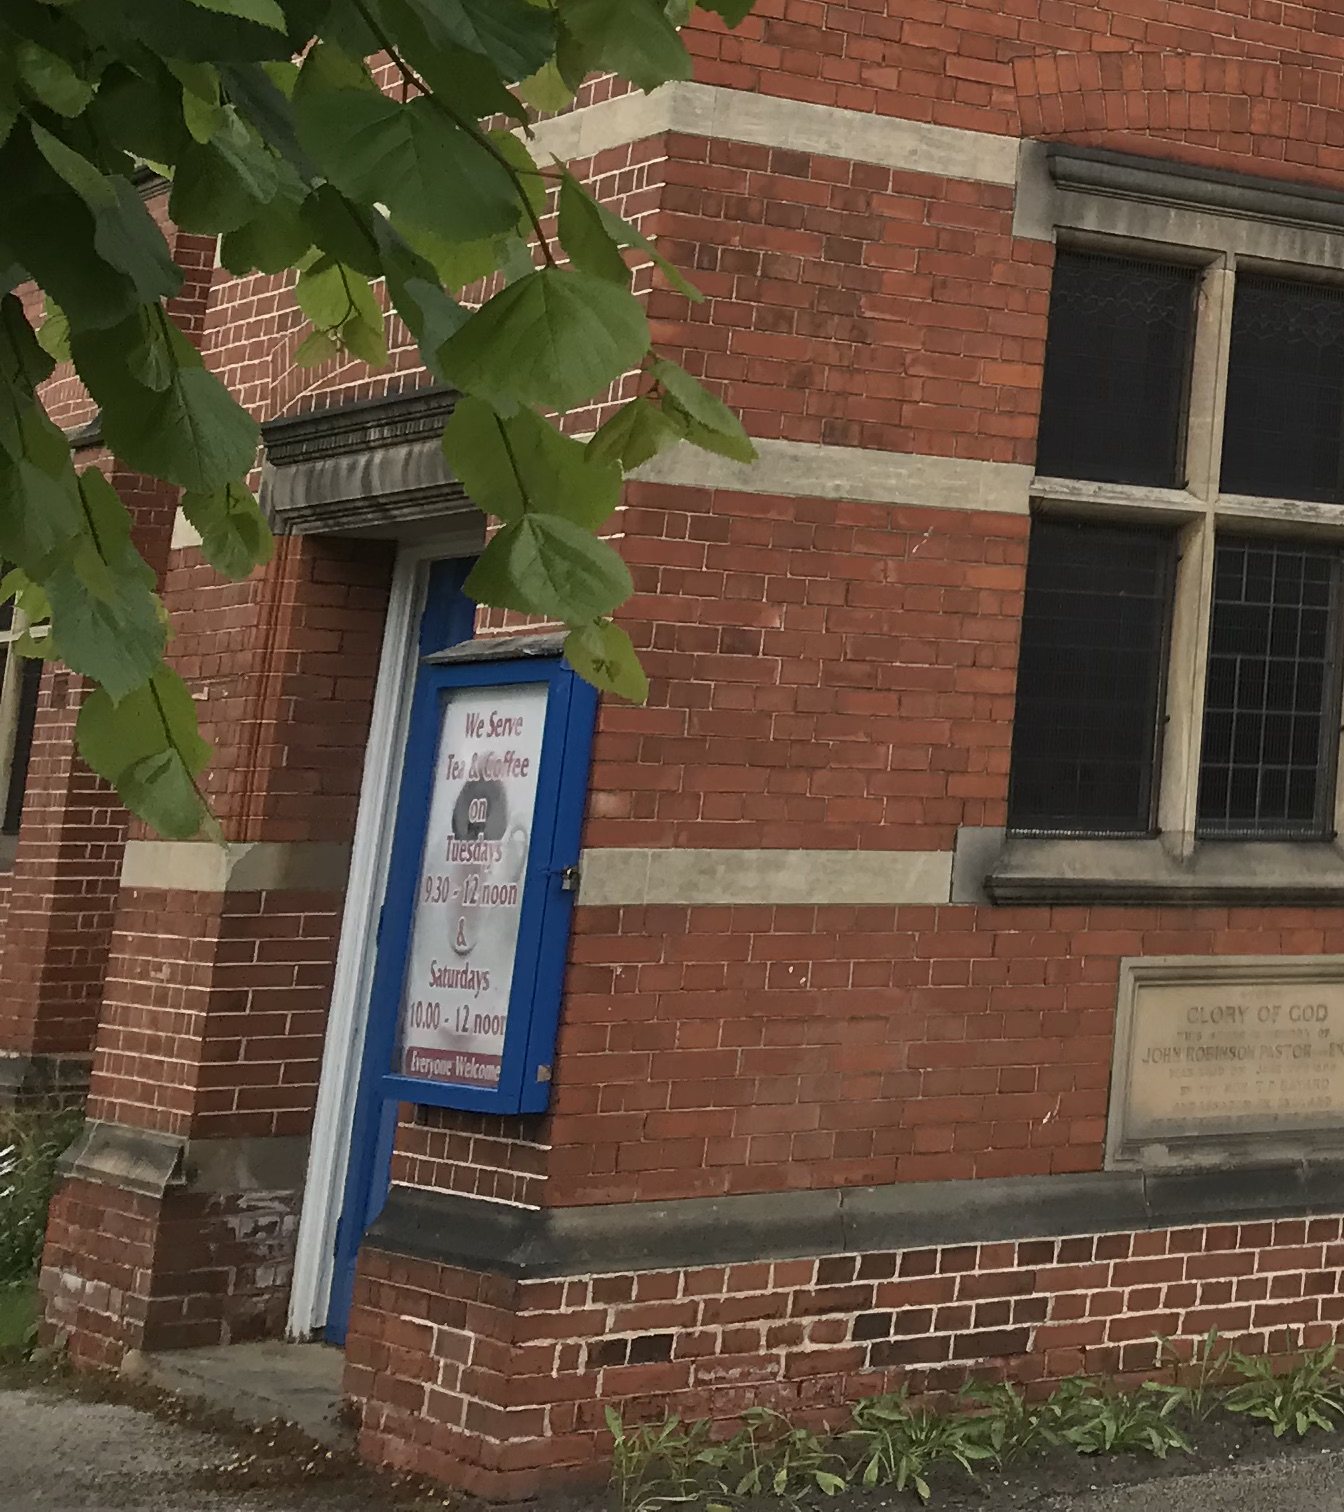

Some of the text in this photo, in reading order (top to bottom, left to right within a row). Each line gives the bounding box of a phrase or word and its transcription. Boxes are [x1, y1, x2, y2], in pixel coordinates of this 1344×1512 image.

[465, 710, 524, 739] We Serve
[446, 750, 530, 781] Tea & Coffee
[468, 798, 488, 823] on
[446, 833, 503, 873] Tuesdays
[463, 875, 480, 904] 12
[482, 884, 518, 905] noon
[456, 916, 467, 947] &
[428, 959, 490, 999] Saturdays
[410, 1000, 441, 1030] 10.00
[455, 1004, 470, 1033] 12
[410, 1050, 501, 1082] Everyone Welcome
